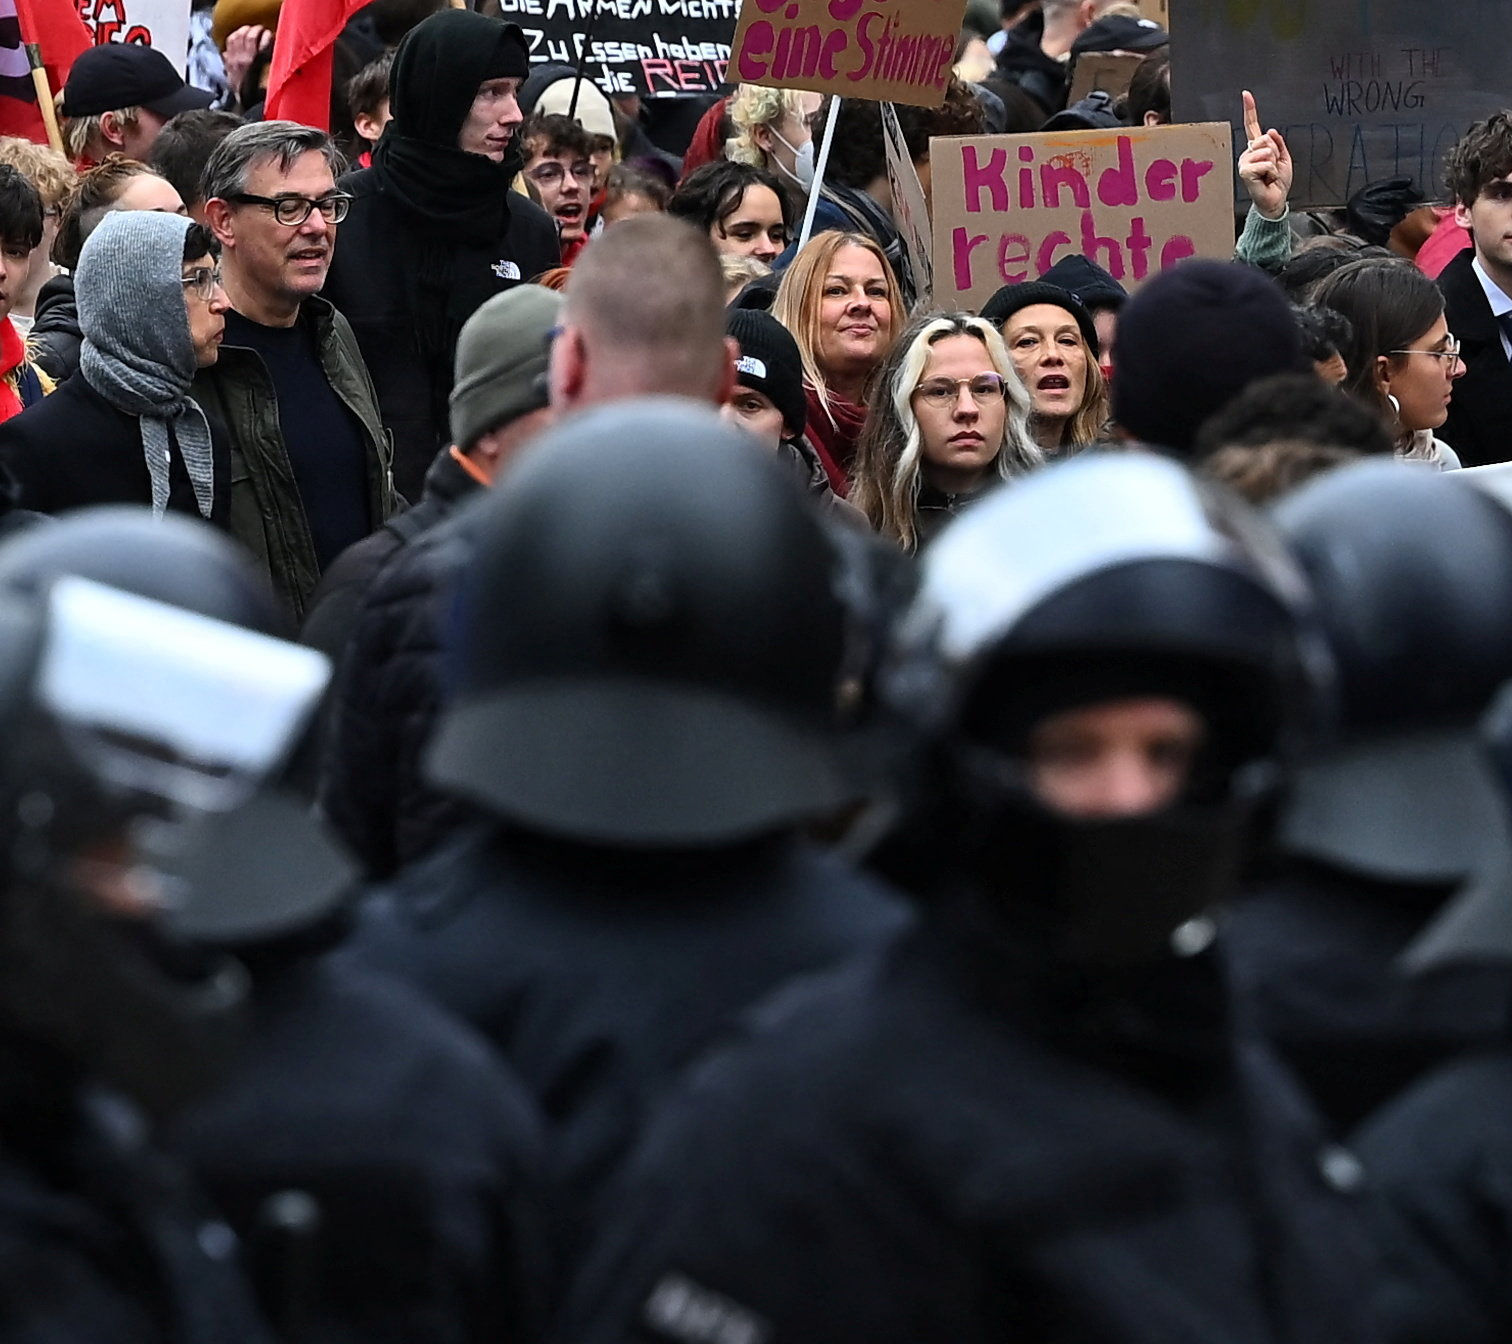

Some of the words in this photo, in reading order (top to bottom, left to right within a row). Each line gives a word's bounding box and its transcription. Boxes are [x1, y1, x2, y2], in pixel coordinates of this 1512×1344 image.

[738, 3, 849, 81] eine
[846, 10, 956, 90] Stimme
[1322, 80, 1426, 117] WRONG
[961, 135, 1214, 213] Kinder
[952, 210, 1195, 291] rechte
